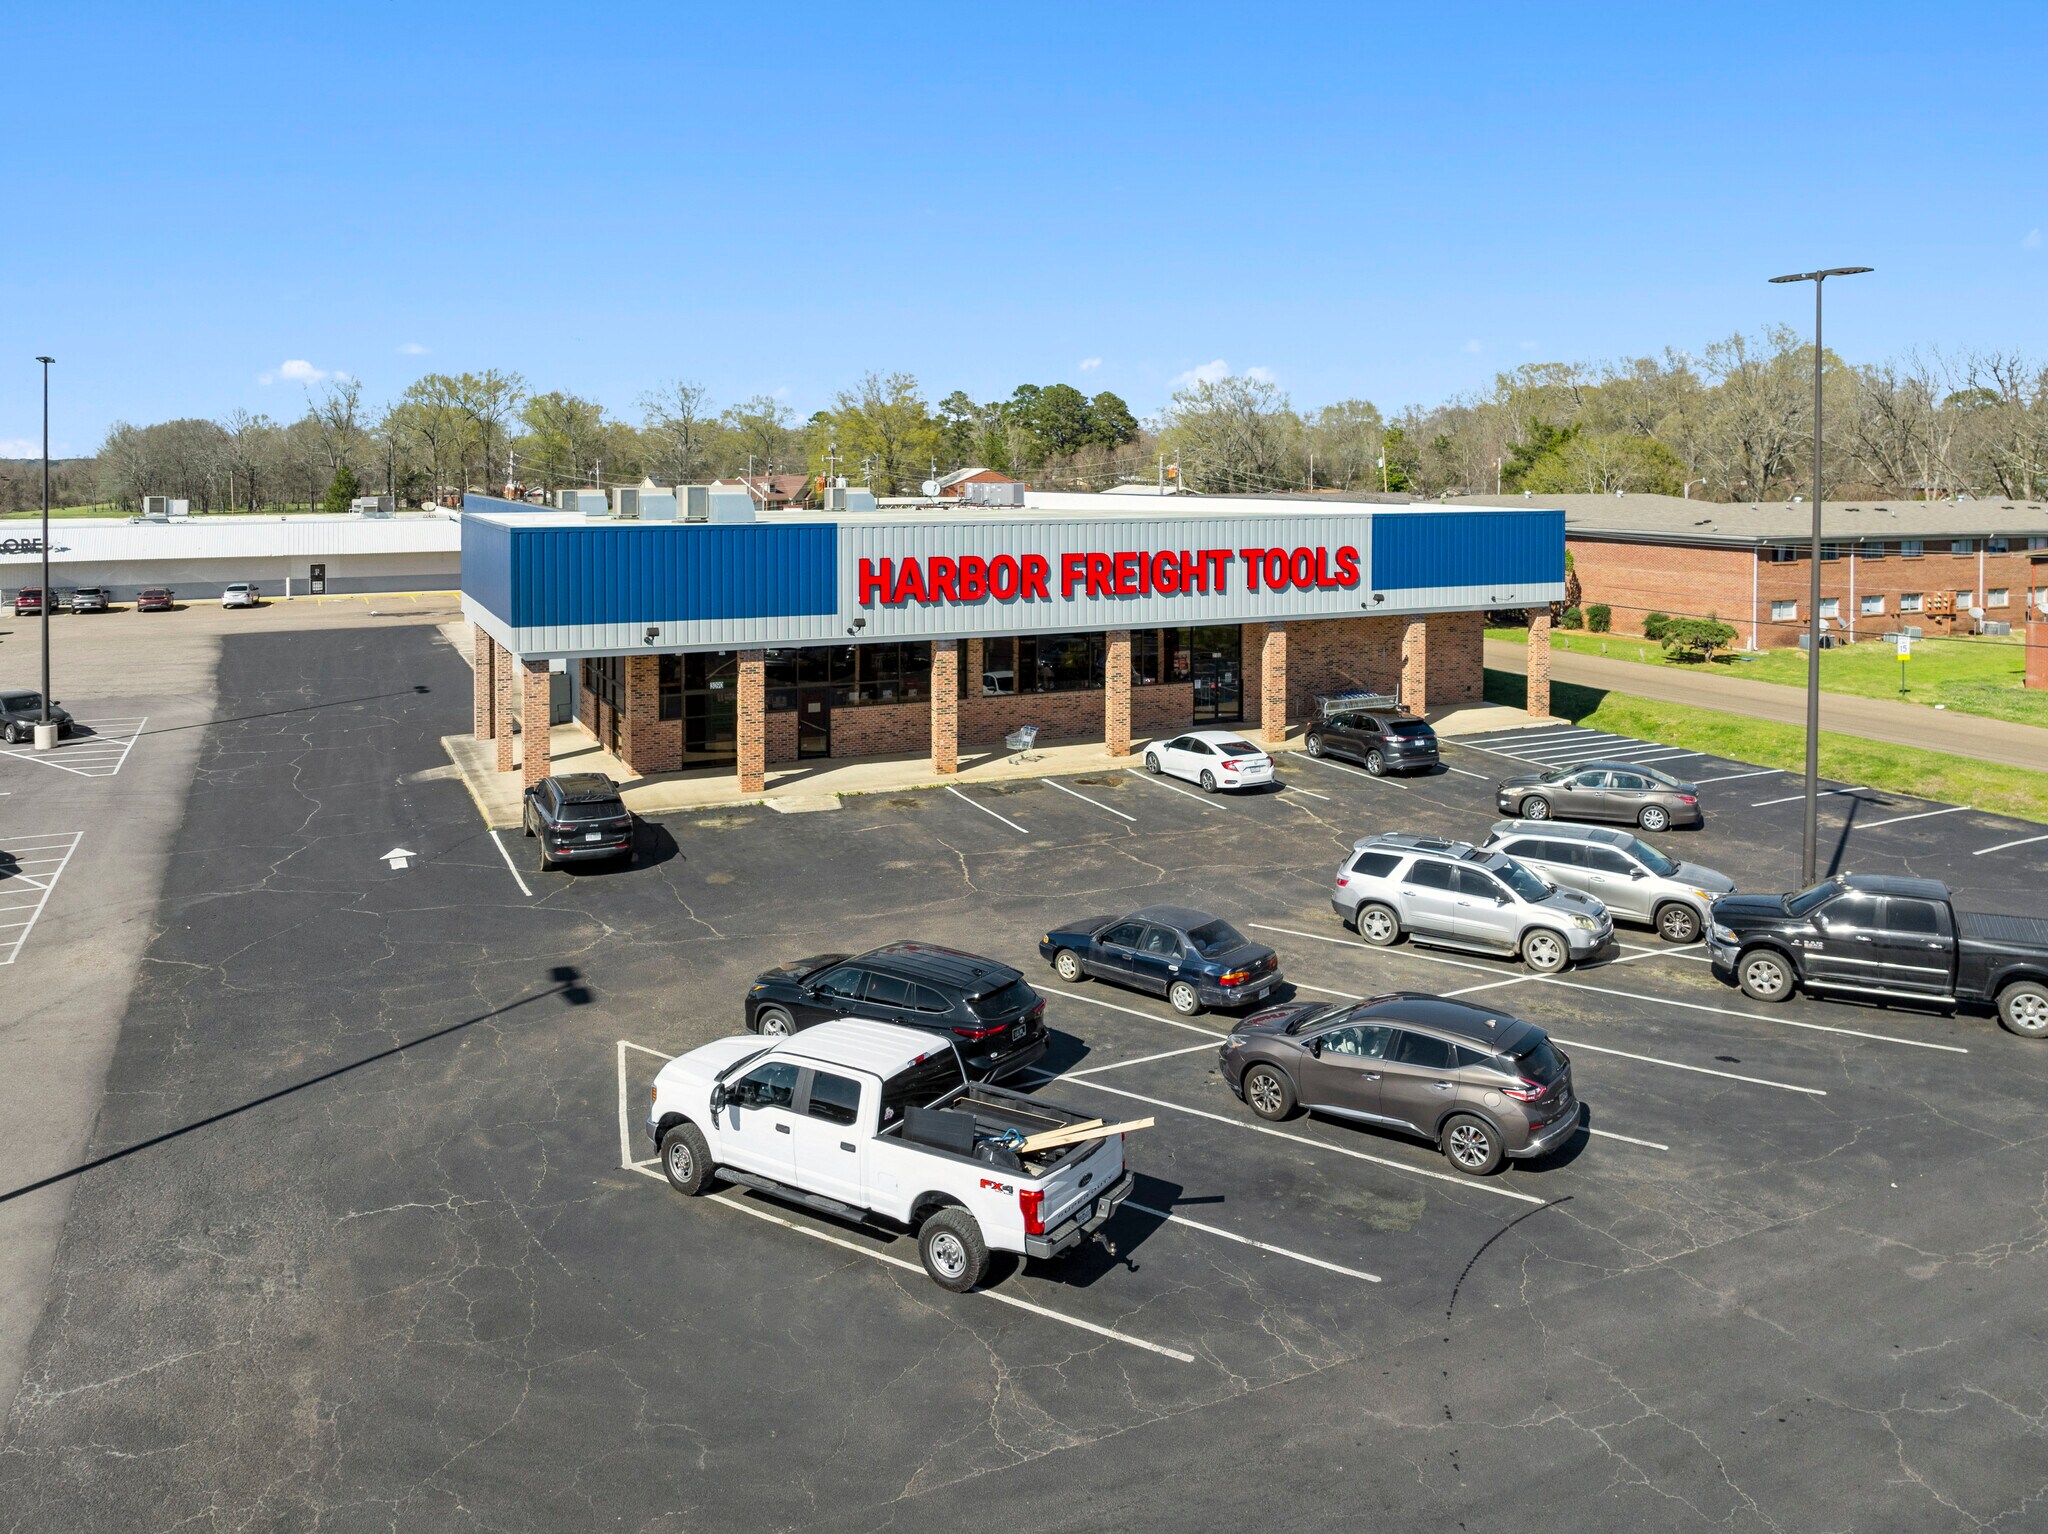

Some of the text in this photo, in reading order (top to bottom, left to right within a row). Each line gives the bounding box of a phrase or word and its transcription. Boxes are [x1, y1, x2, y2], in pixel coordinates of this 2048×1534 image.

[859, 545, 1360, 605] HARBOR FREIGHT TOOLS
[979, 1178, 1014, 1195] FX4
[1057, 1193, 1089, 1219] SUPER
